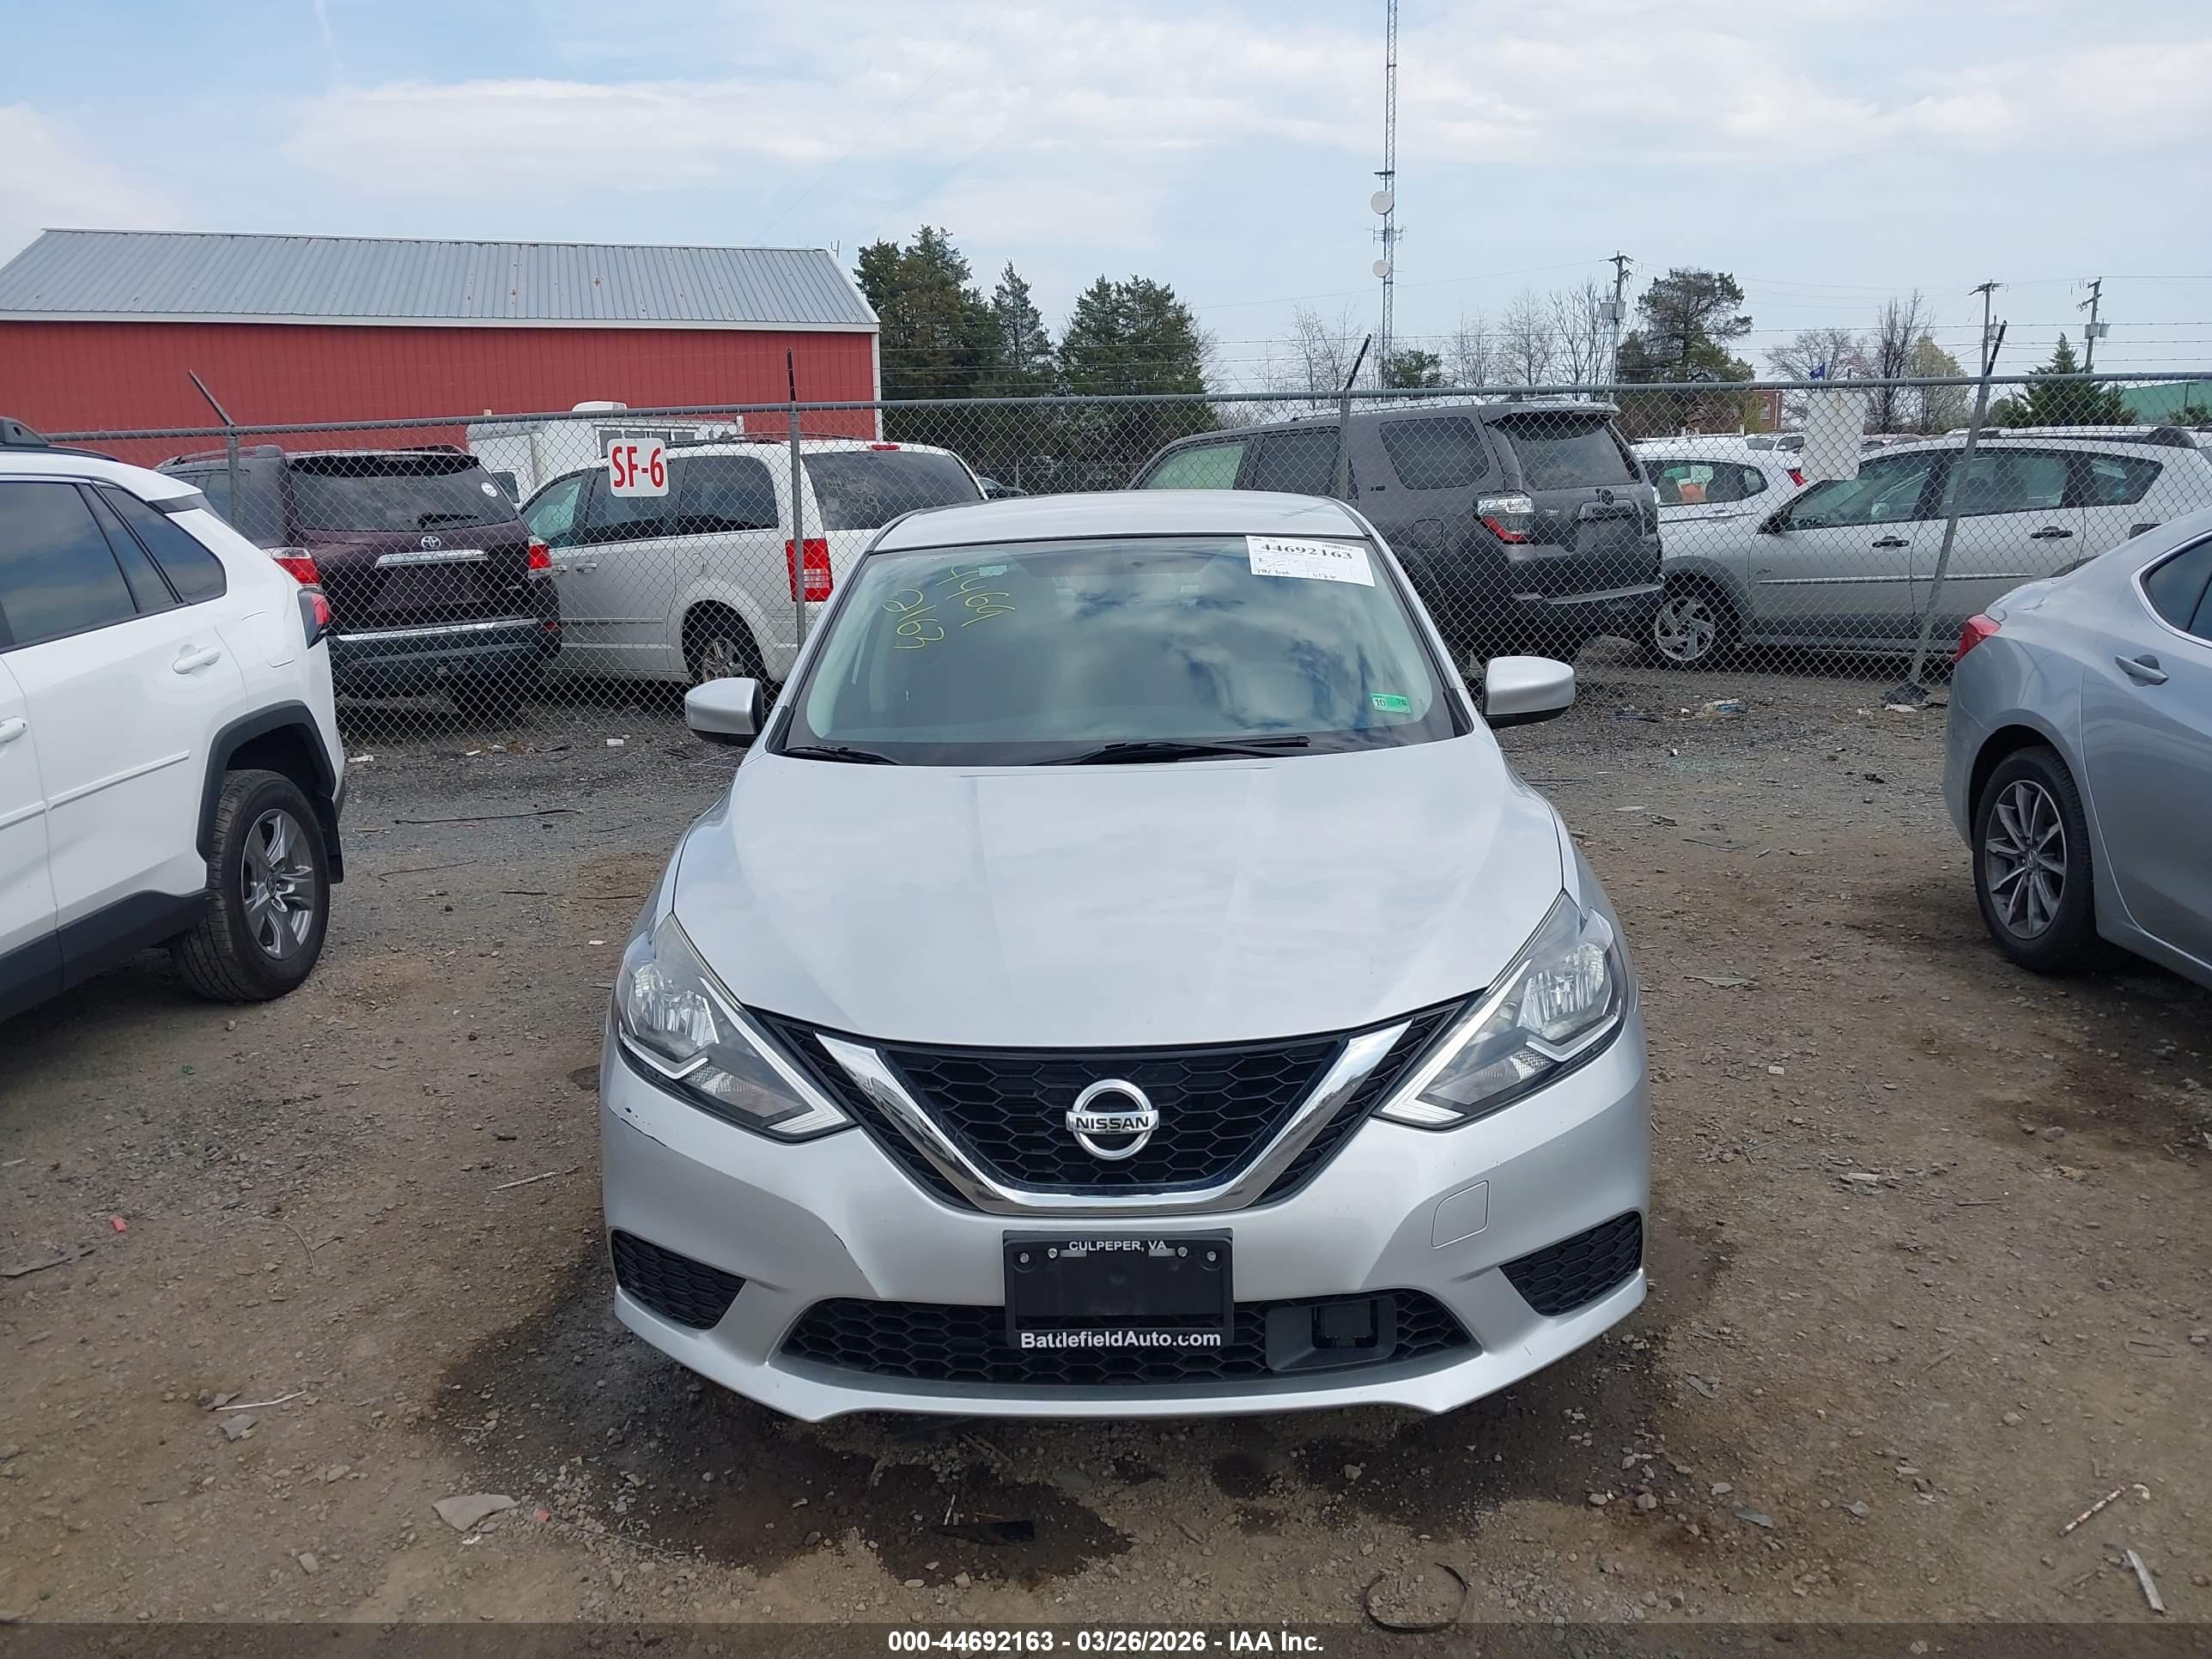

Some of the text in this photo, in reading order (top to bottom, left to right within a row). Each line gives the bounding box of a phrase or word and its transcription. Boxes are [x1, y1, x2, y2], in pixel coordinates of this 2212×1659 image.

[611, 446, 665, 488] SF-6
[1261, 544, 1353, 559] 44692163
[1375, 698, 1386, 707] 10
[1076, 1116, 1149, 1129] NISSAN
[1069, 1240, 1167, 1252] CULPEPER, VA
[1021, 1331, 1221, 1349] BattlefieldAuto.com
